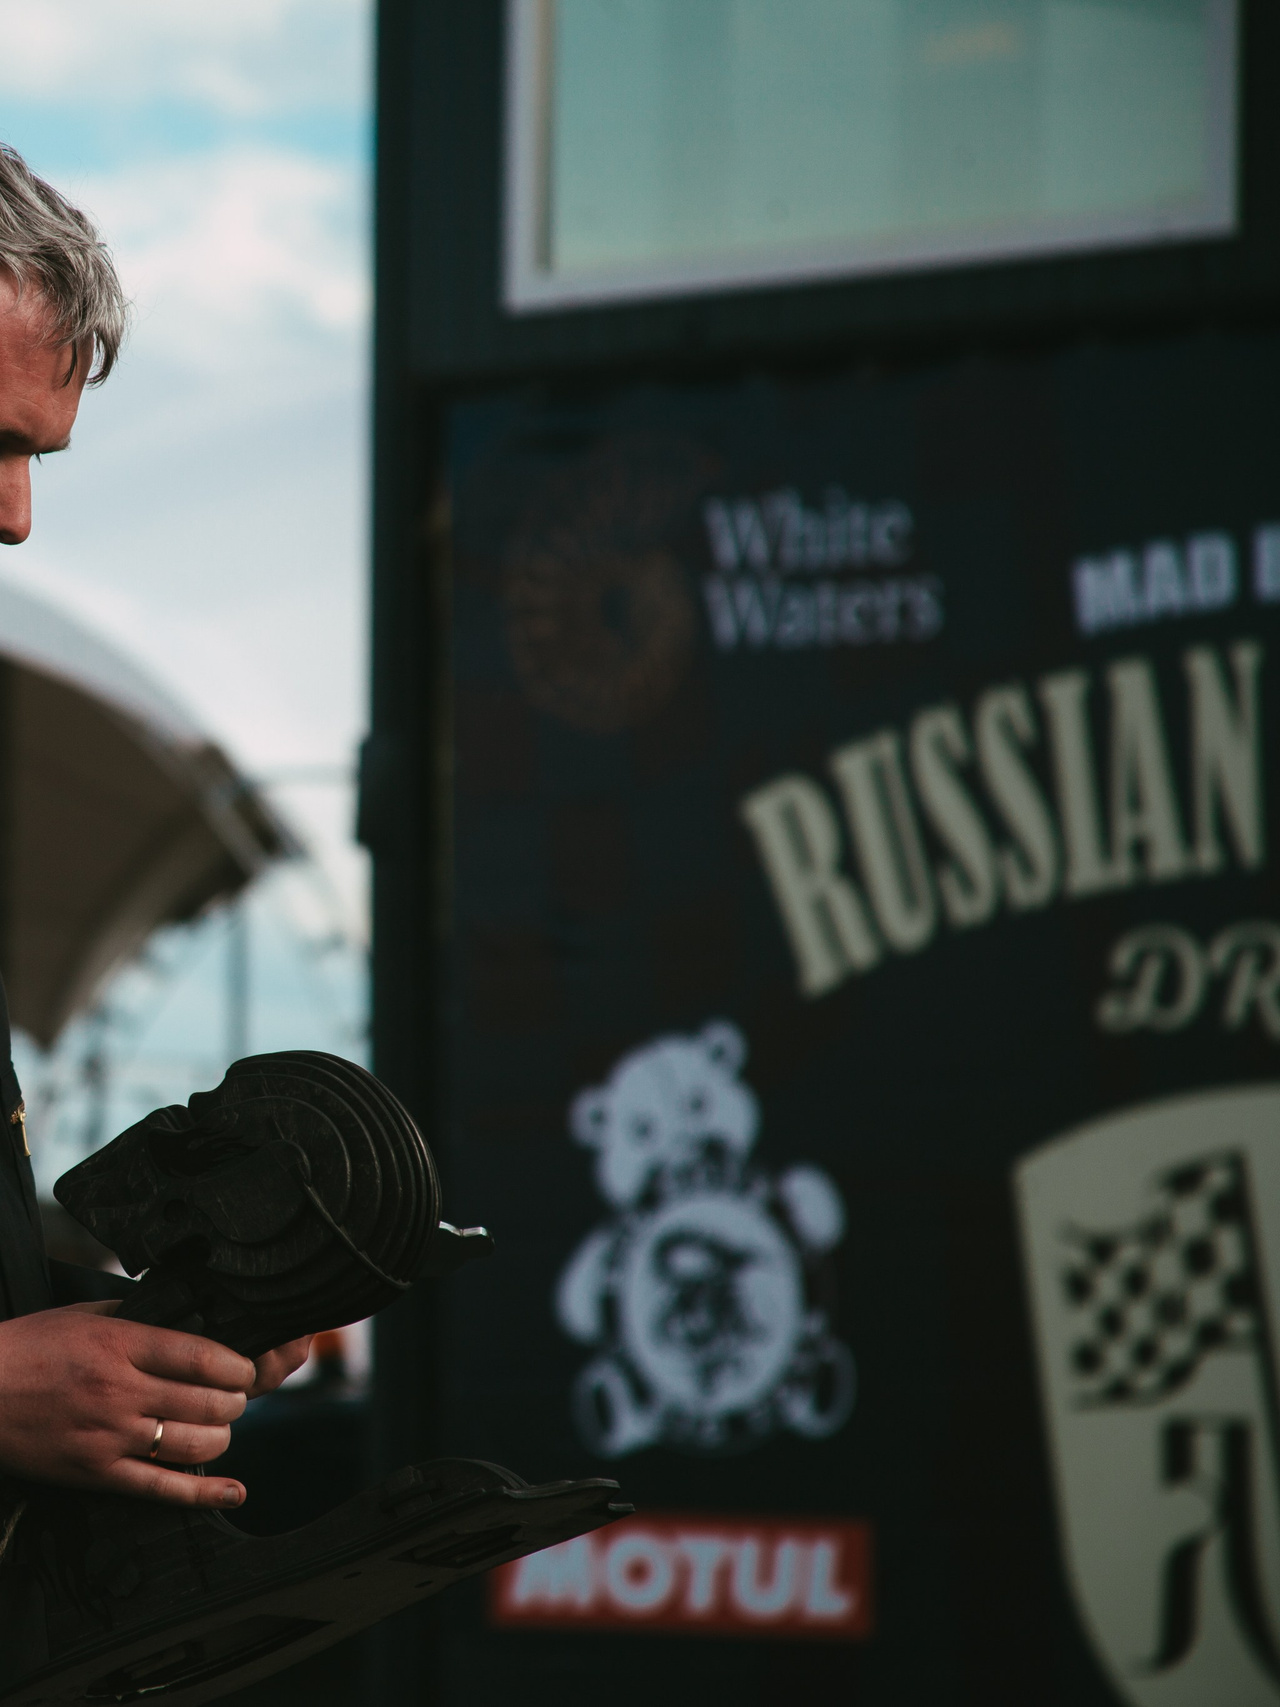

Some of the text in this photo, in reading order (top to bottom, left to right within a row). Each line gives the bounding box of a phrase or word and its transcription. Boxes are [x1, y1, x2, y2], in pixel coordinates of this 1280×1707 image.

[703, 486, 914, 570] White
[702, 574, 945, 650] Waters
[1073, 533, 1237, 634] MAD
[742, 639, 1266, 997] RUSSIAN
[513, 1535, 851, 1617] MOTUL
